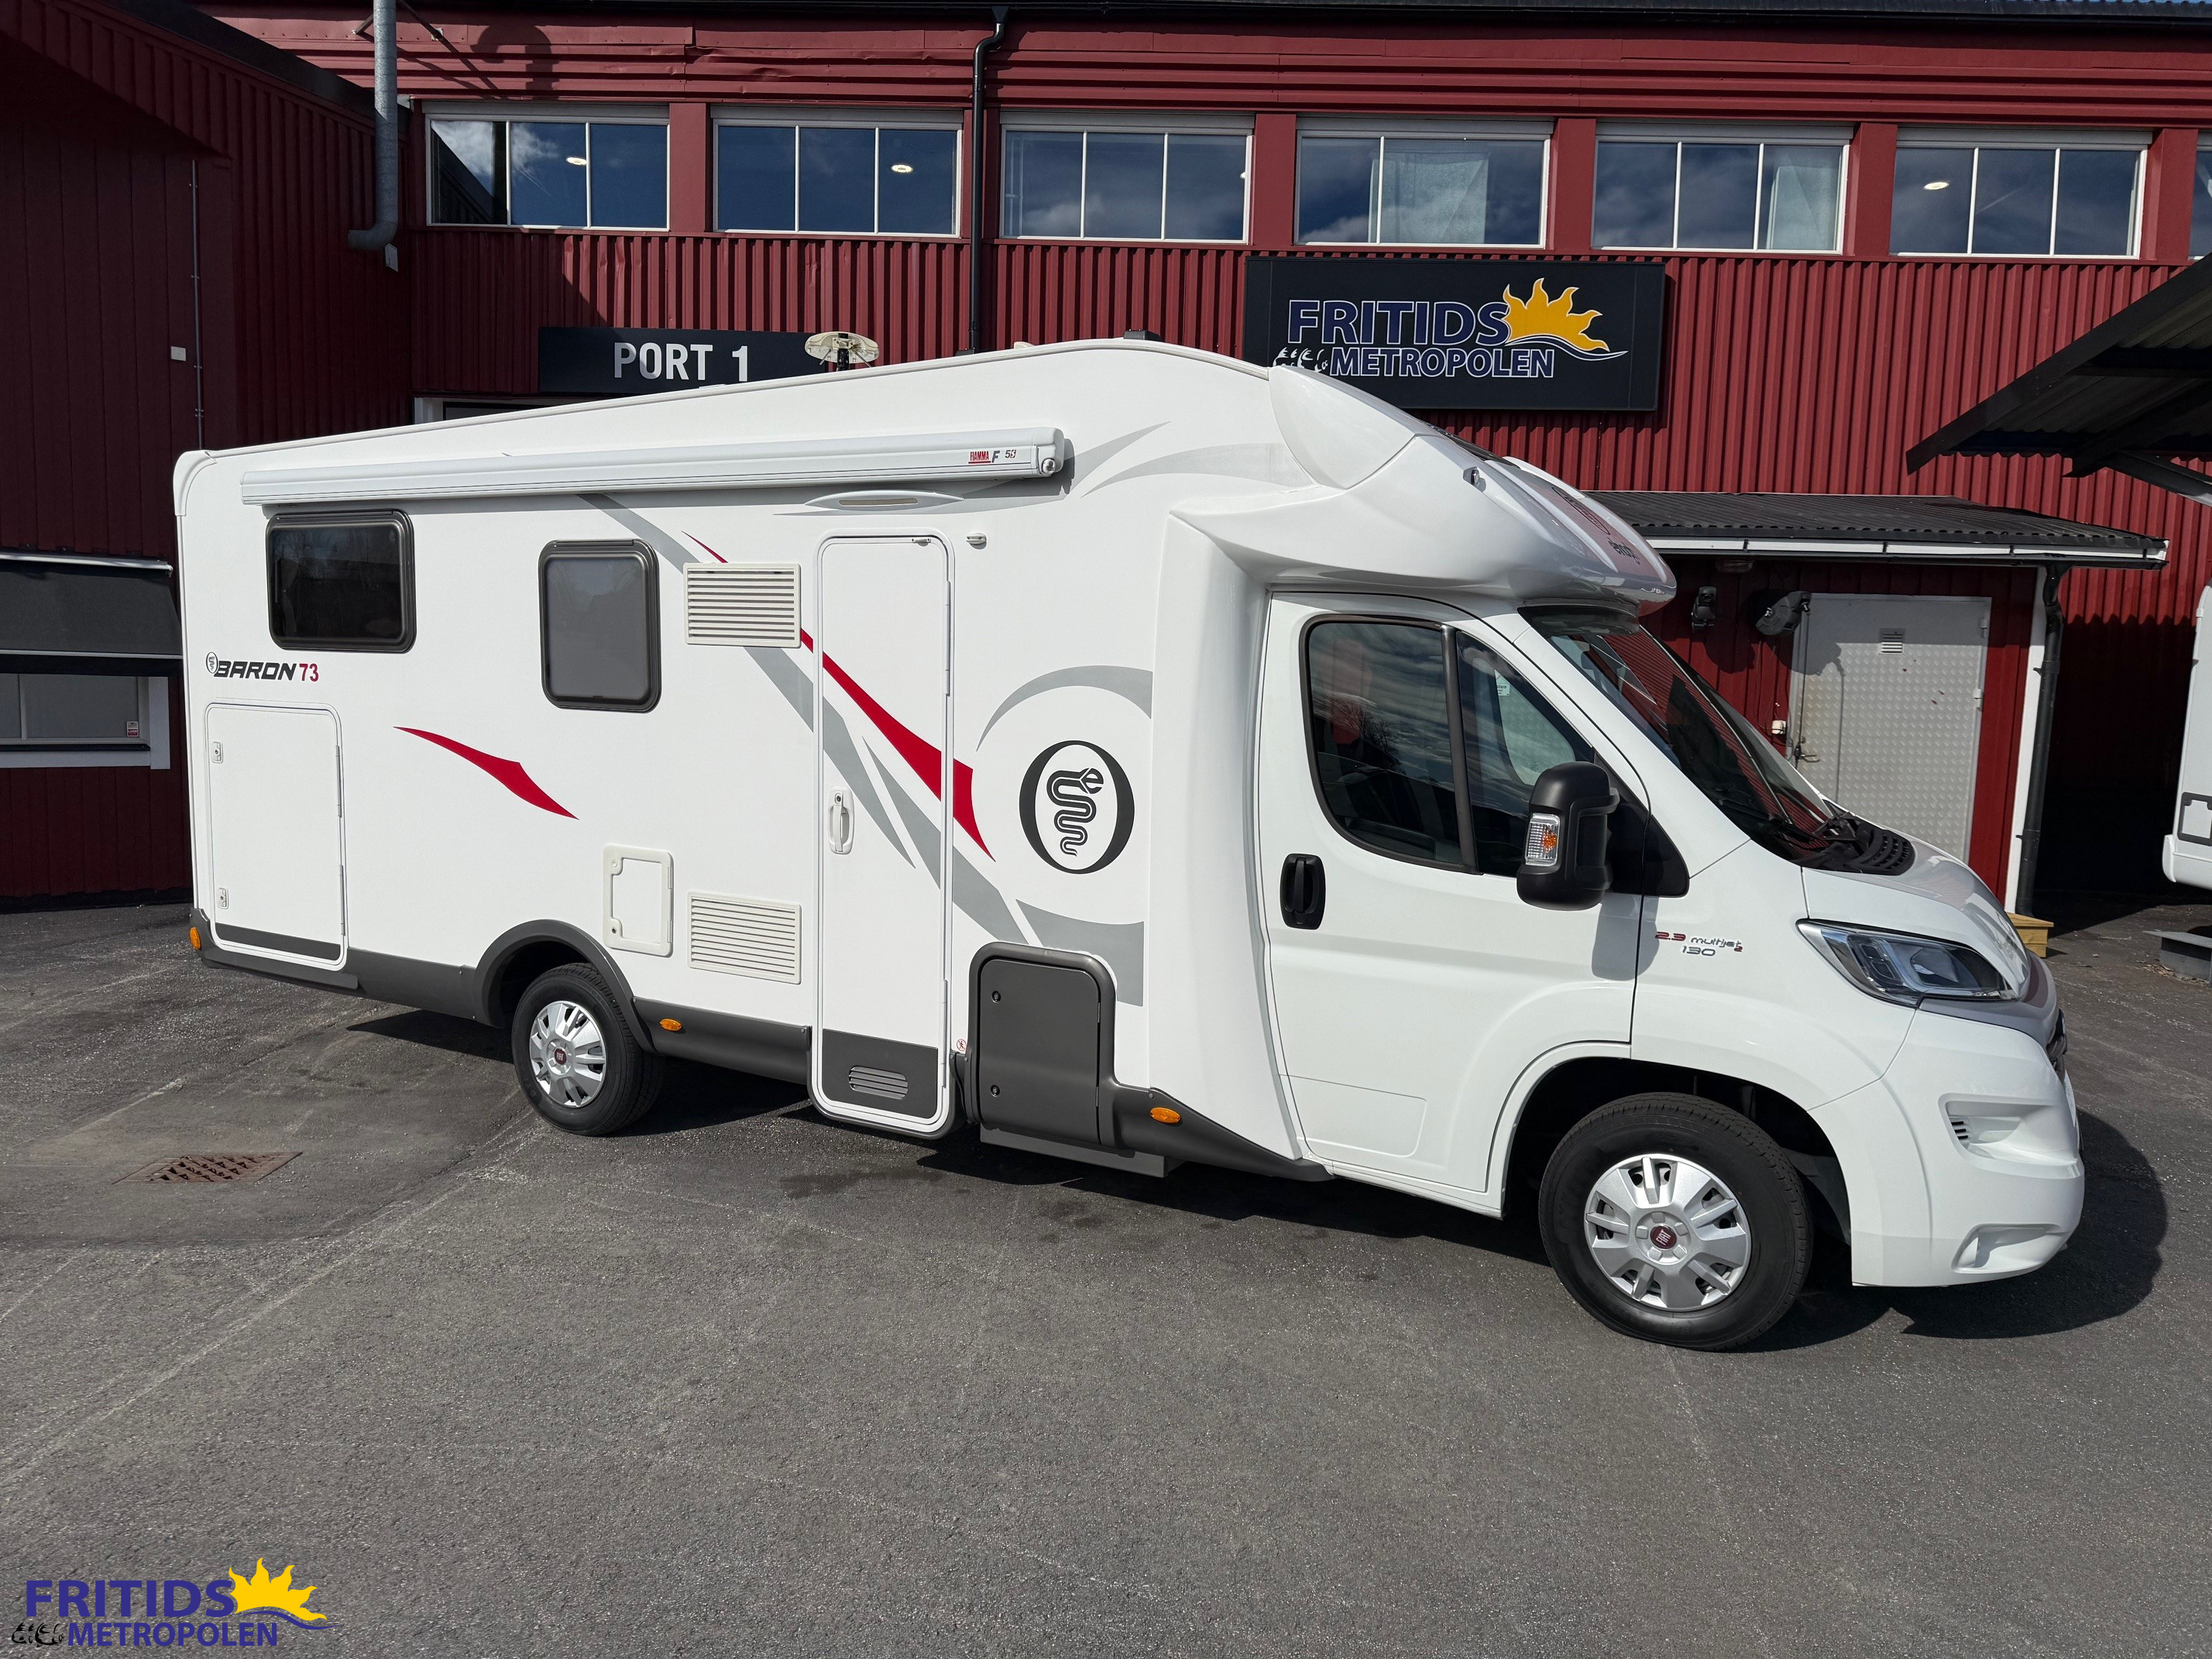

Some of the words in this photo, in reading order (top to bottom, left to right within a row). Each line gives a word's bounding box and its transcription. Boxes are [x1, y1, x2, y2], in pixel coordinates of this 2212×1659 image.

[1288, 300, 1509, 346] FRITIDS
[614, 342, 713, 381] PORT
[732, 345, 748, 382] 1
[1330, 347, 1554, 378] METROPOLEN
[970, 451, 990, 462] FIAMMA
[214, 661, 297, 681] BARON
[299, 663, 319, 682] 73
[1654, 931, 1686, 941] 2.3
[1682, 946, 1716, 957] 130
[1655, 1228, 1671, 1245] FIAT
